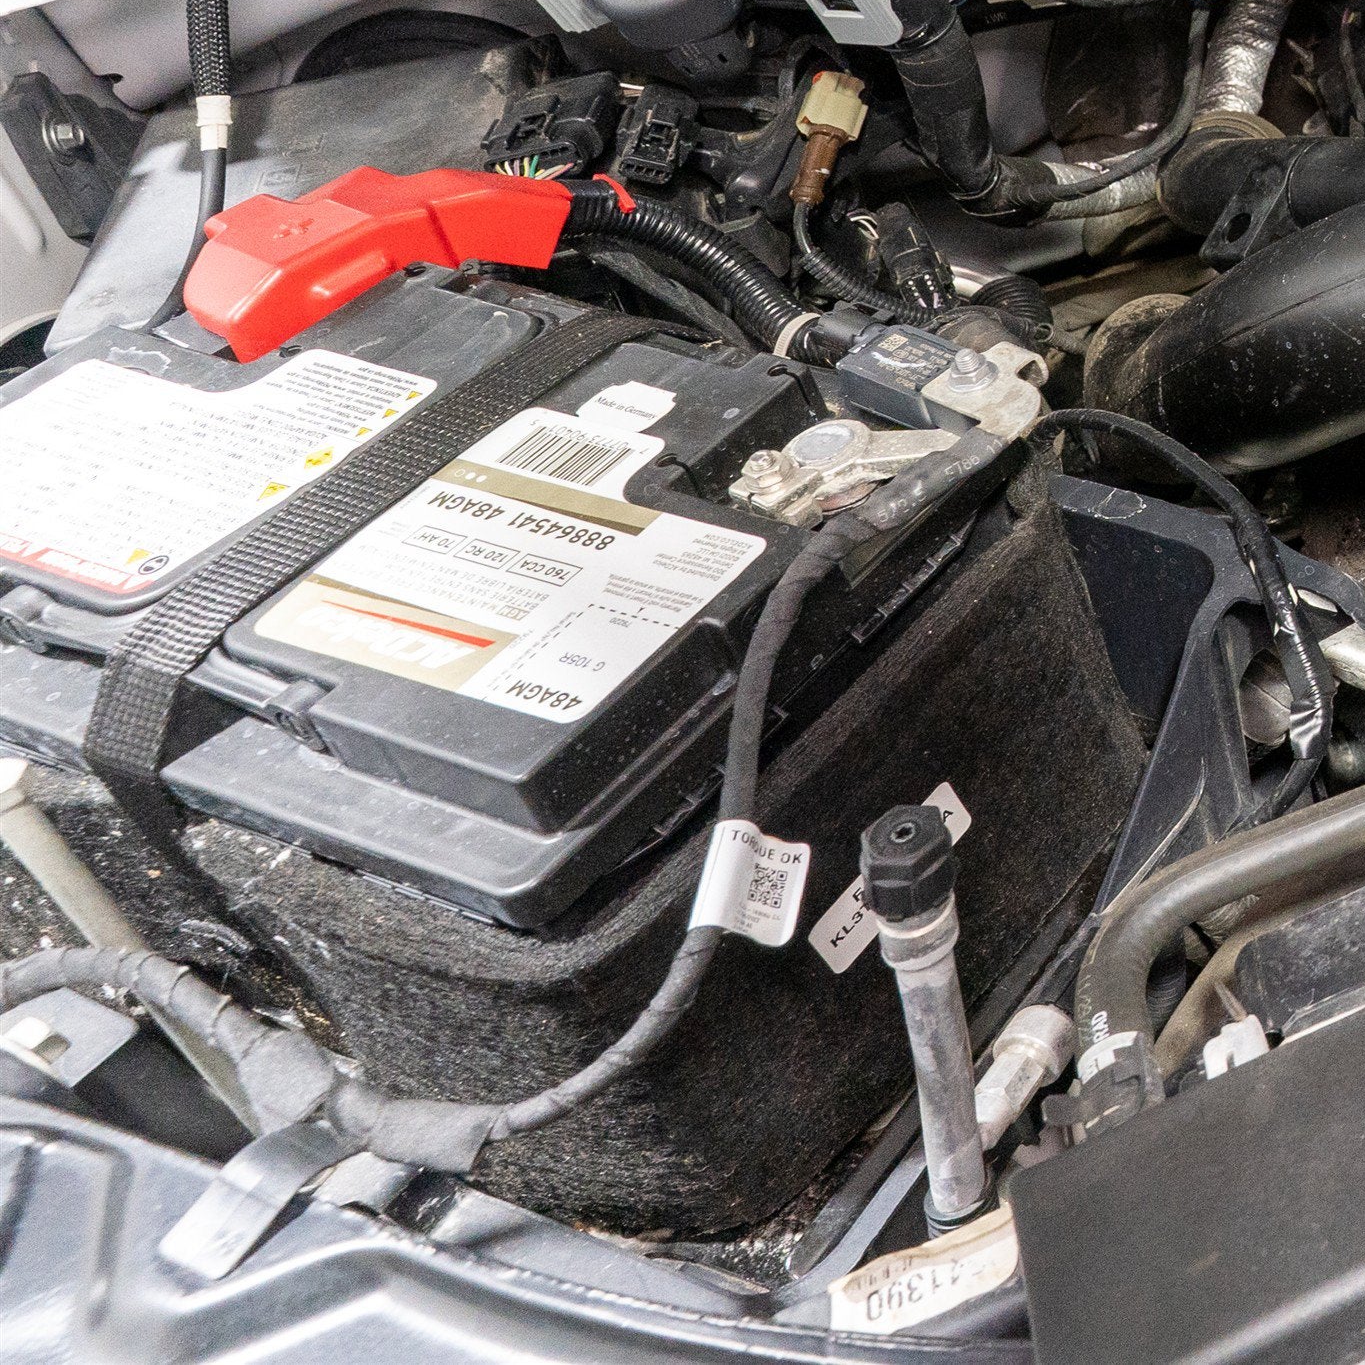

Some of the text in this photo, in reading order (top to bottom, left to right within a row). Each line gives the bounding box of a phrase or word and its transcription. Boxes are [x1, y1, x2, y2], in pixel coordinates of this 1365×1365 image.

[424, 489, 509, 522] 48AGM
[504, 511, 619, 552] 88864541
[435, 537, 456, 548] 70
[462, 544, 509, 563] 120 RC
[516, 558, 573, 580] 760 CCA
[487, 591, 541, 611] BATTERIE
[555, 651, 609, 672] G 105R
[502, 679, 587, 712] 48AGM
[780, 852, 803, 864] OK
